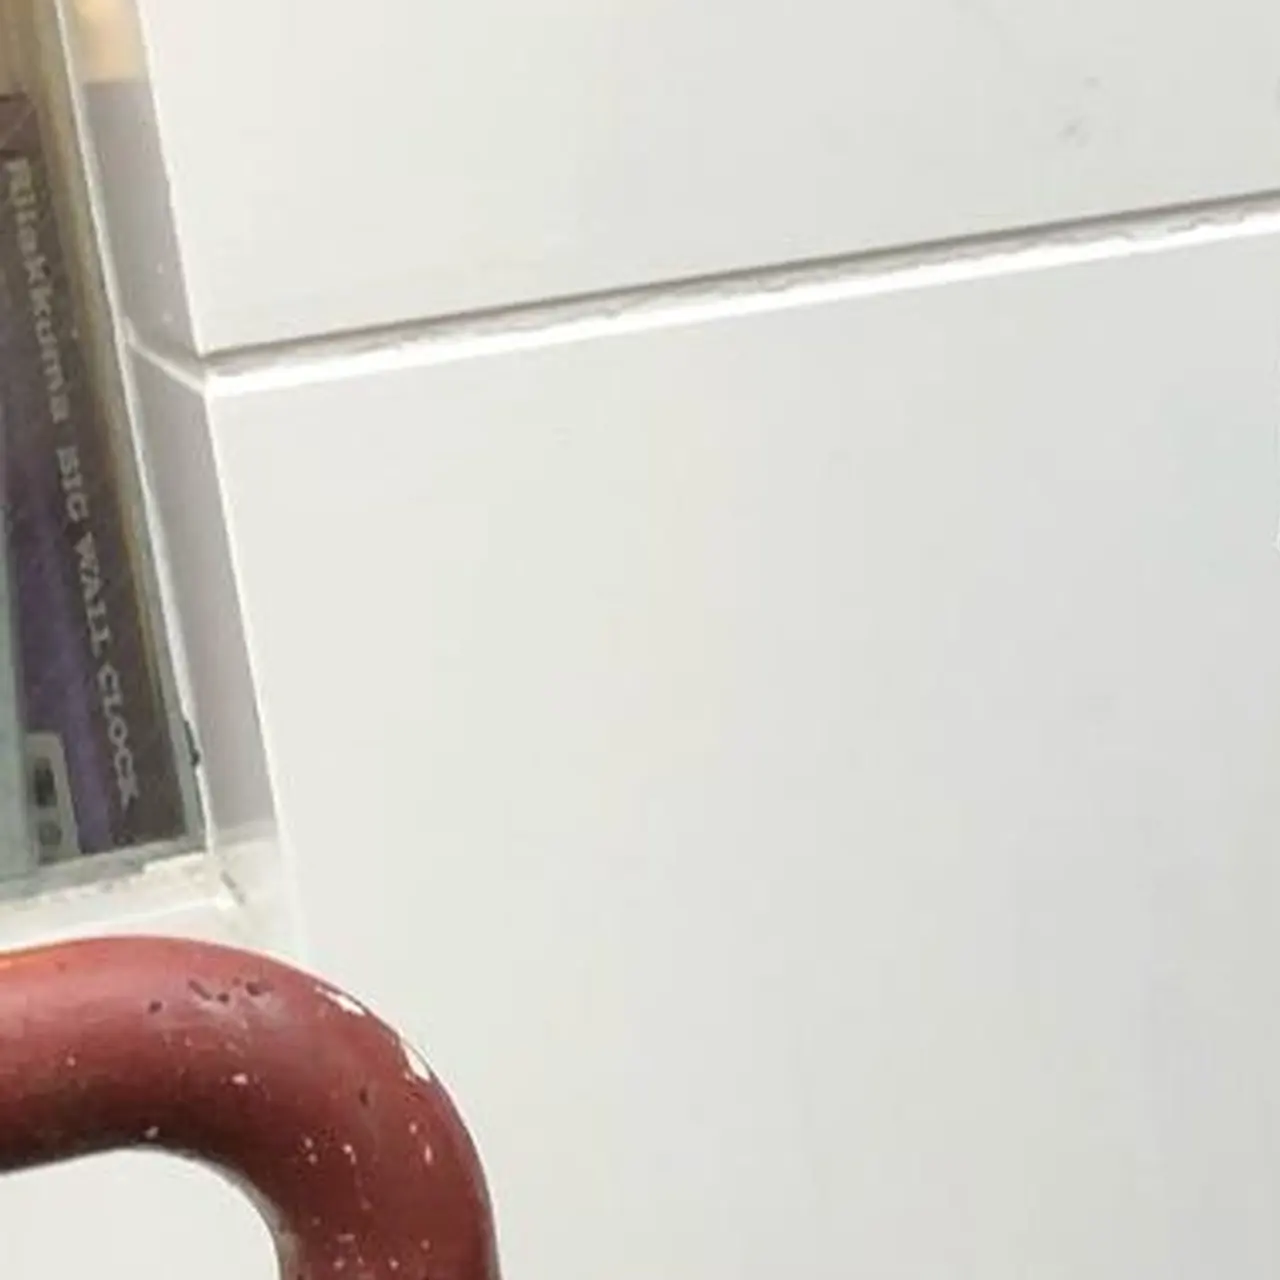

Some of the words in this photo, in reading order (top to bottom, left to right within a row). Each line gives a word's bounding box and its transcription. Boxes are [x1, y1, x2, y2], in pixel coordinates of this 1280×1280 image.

[56, 446, 88, 521] BIG
[75, 531, 111, 658] WALL
[98, 663, 140, 812] CLOCK
